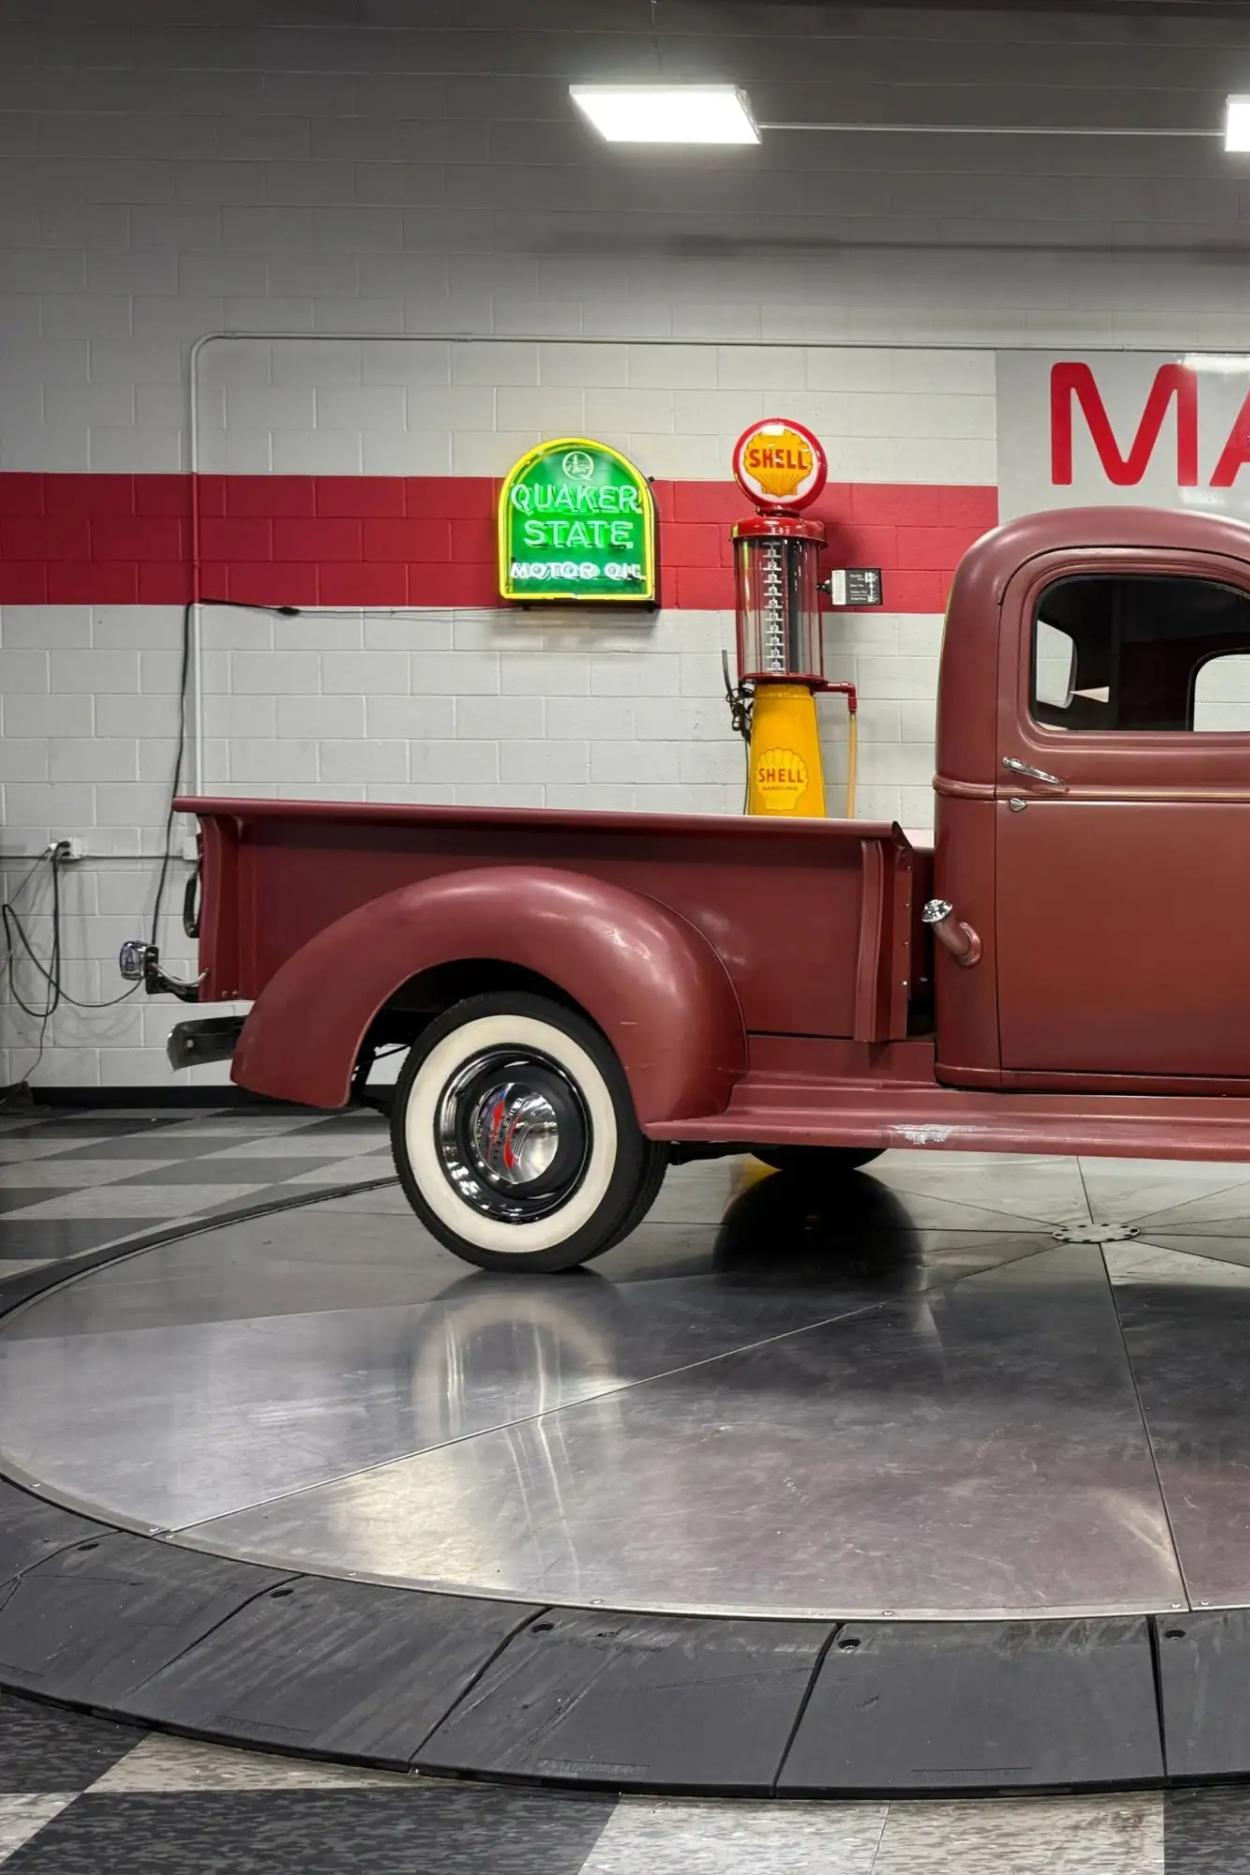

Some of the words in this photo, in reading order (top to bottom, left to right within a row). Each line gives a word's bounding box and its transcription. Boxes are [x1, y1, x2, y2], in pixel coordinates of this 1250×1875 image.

[749, 448, 808, 471] SHELL
[511, 483, 642, 516] QUAKER
[524, 519, 634, 549] STATE
[510, 562, 600, 580] MOTOR
[604, 562, 646, 580] OIL
[758, 768, 804, 783] SHELL
